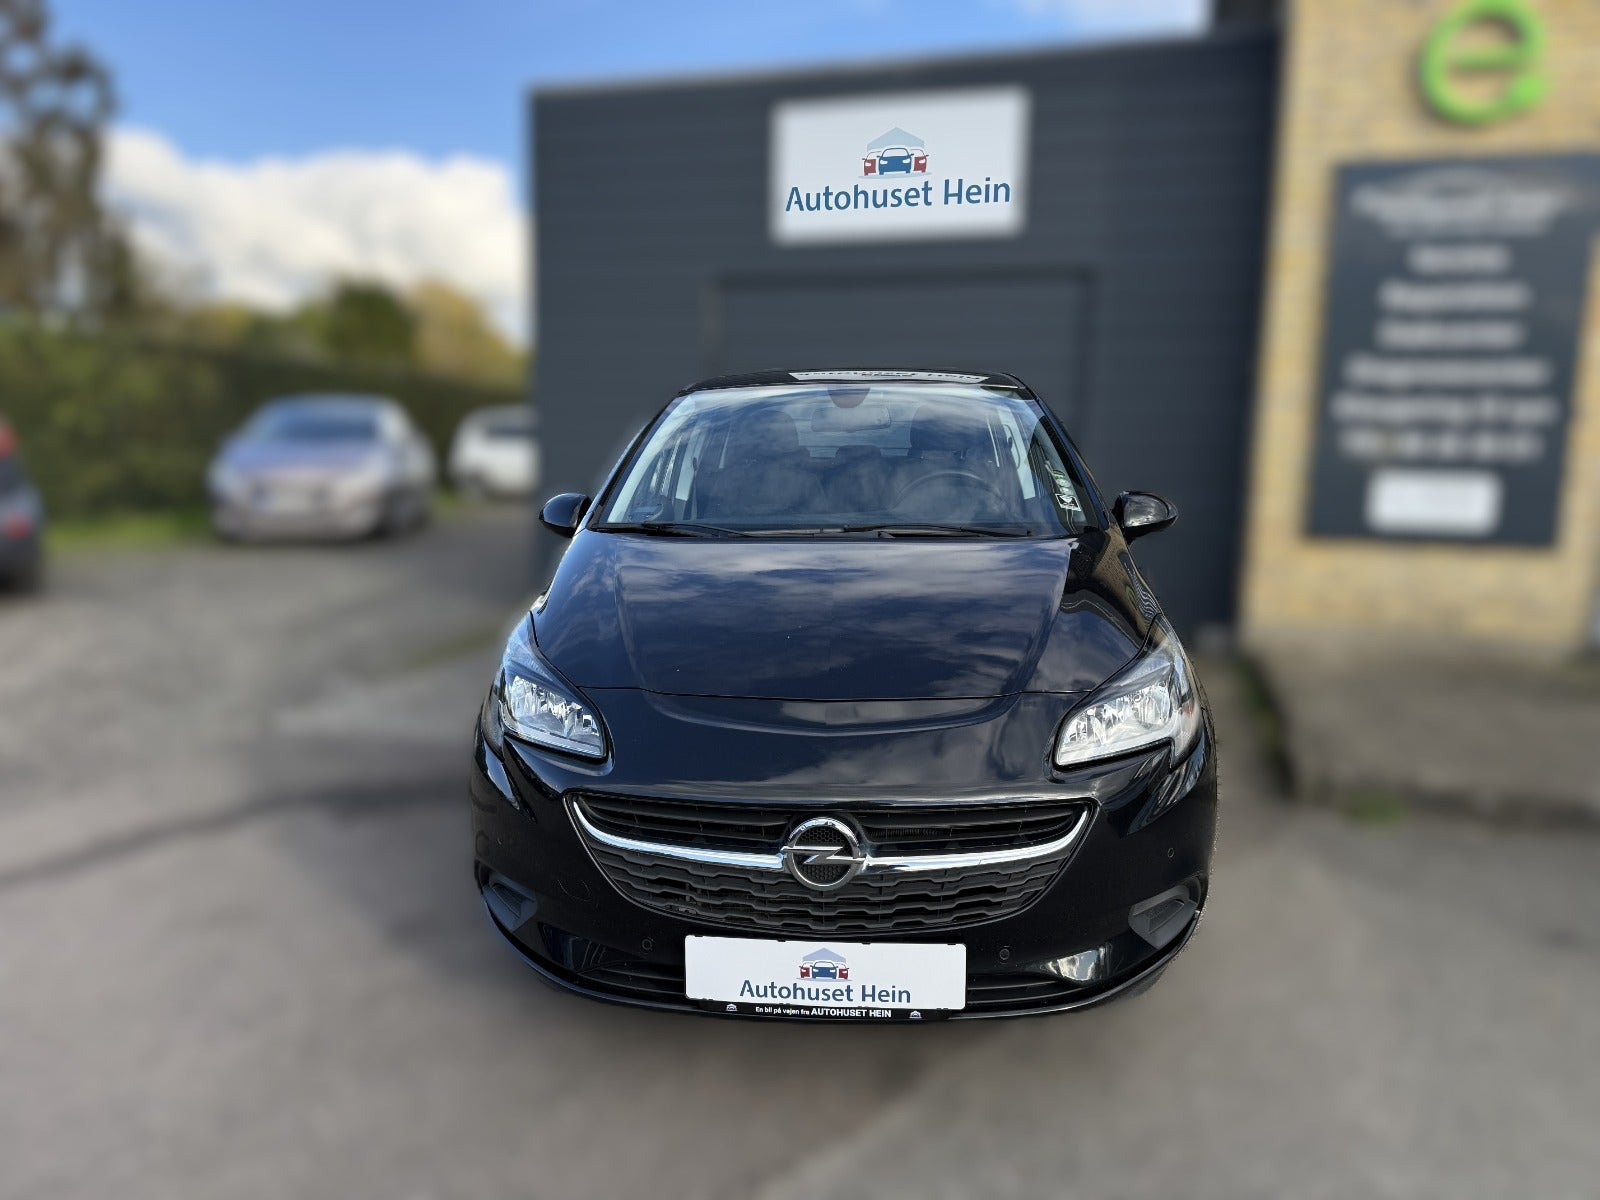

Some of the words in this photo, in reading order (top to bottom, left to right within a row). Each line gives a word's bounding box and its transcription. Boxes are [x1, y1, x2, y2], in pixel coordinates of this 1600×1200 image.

[785, 180, 932, 212] Autohuset
[943, 177, 1011, 205] Hein
[740, 979, 853, 1002] Autohuset
[861, 985, 911, 1003] Hein
[810, 1007, 867, 1017] AUTOHUSET
[868, 1009, 892, 1018] HEIN
